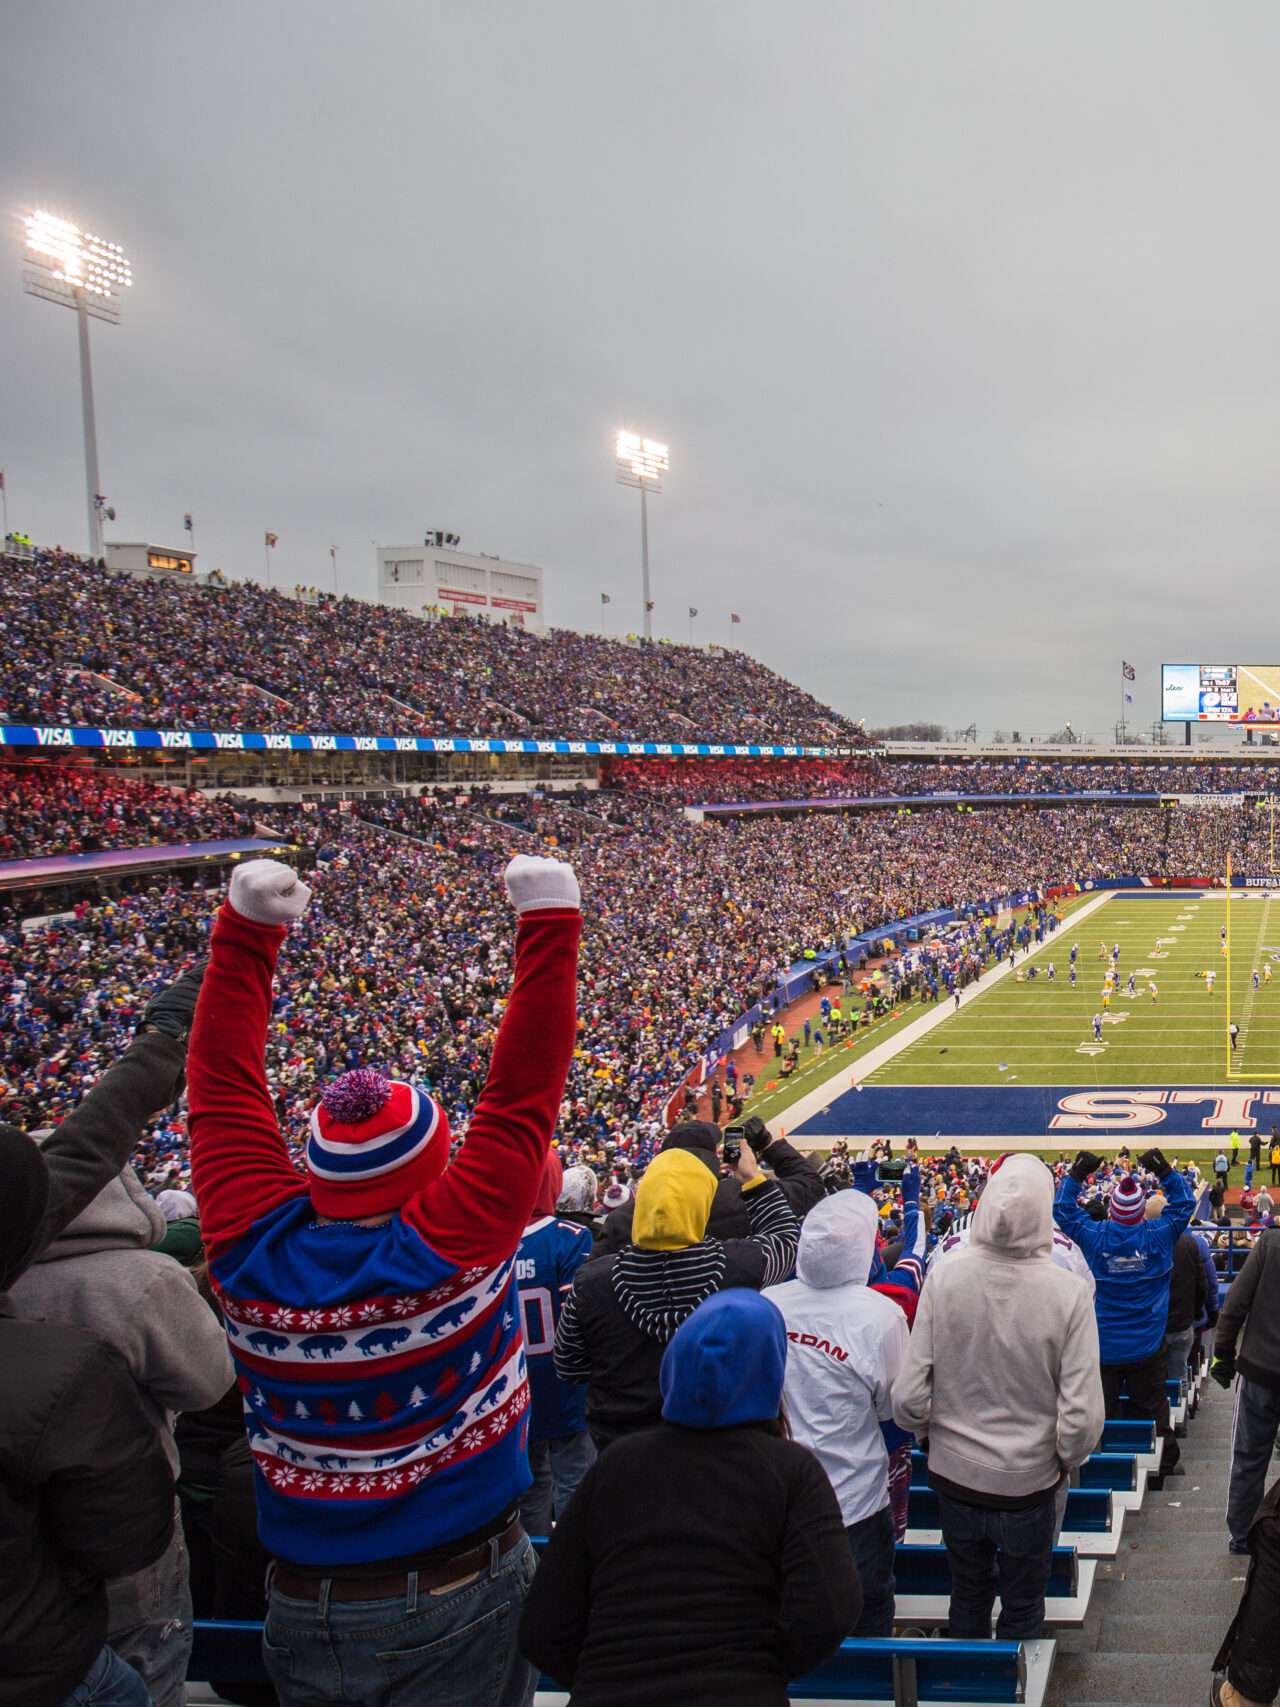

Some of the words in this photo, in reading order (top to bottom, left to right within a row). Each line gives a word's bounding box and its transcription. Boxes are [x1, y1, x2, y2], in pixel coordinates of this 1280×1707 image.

[33, 728, 72, 745] VISA
[98, 730, 135, 746] VISA
[157, 732, 191, 747] VISA
[213, 733, 243, 747] VISA
[263, 735, 291, 748] VISA
[309, 736, 336, 748] VISA
[353, 737, 378, 749] VISA
[394, 738, 417, 750] VISA
[432, 739, 454, 750] VISA
[468, 740, 489, 750] VISA
[503, 741, 524, 751] VISA
[536, 742, 556, 751] VISA
[568, 743, 586, 752] VISA
[599, 744, 616, 752] VISA
[627, 744, 644, 753] VISA
[656, 745, 672, 753] VISA
[683, 745, 698, 753] VISA
[516, 1258, 536, 1280] DS
[517, 1286, 555, 1357] 0
[786, 1331, 849, 1362] RDAN
